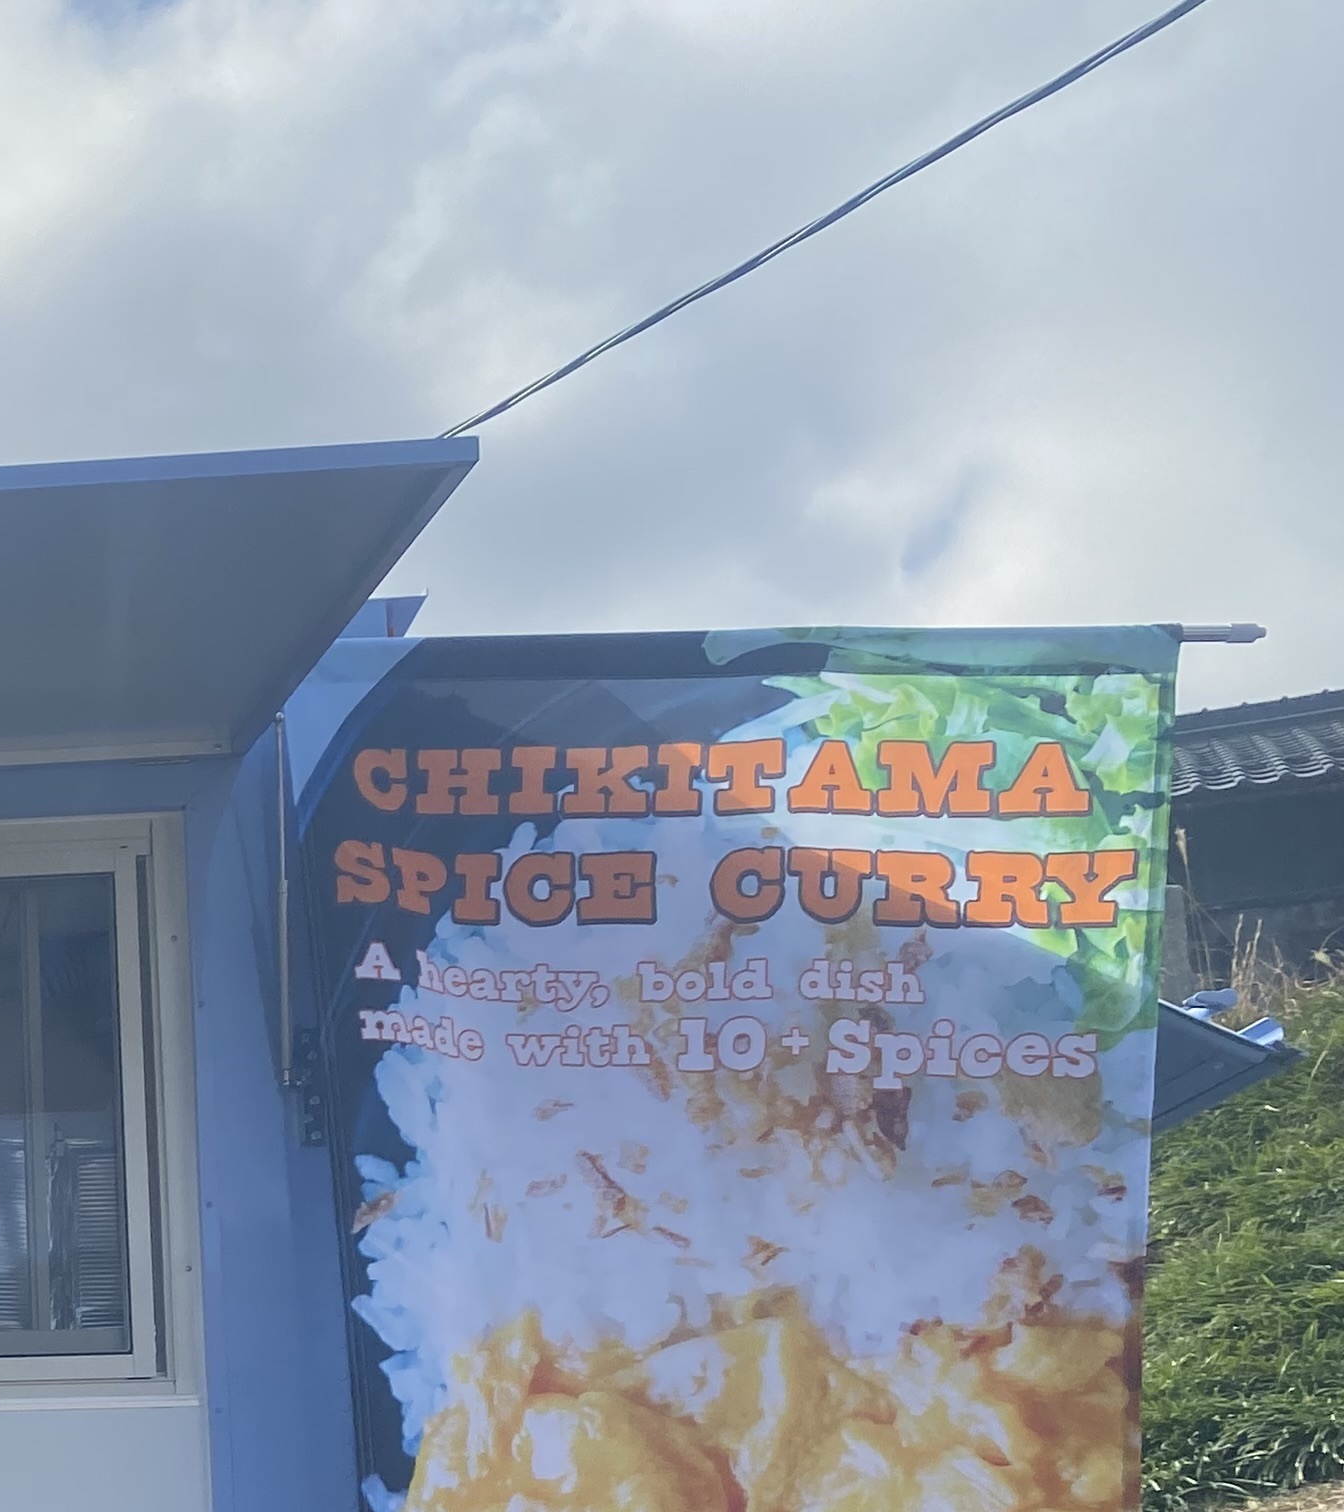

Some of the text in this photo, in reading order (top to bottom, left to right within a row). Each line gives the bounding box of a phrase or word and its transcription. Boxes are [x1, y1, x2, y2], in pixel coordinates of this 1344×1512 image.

[353, 738, 1091, 818] CHIKITAMA
[334, 839, 1137, 929] SPICE CURRY
[355, 941, 926, 1011] A hearty, bold dish
[359, 1007, 485, 1063] made
[506, 1024, 652, 1069] with
[825, 1018, 1098, 1090] Spices
